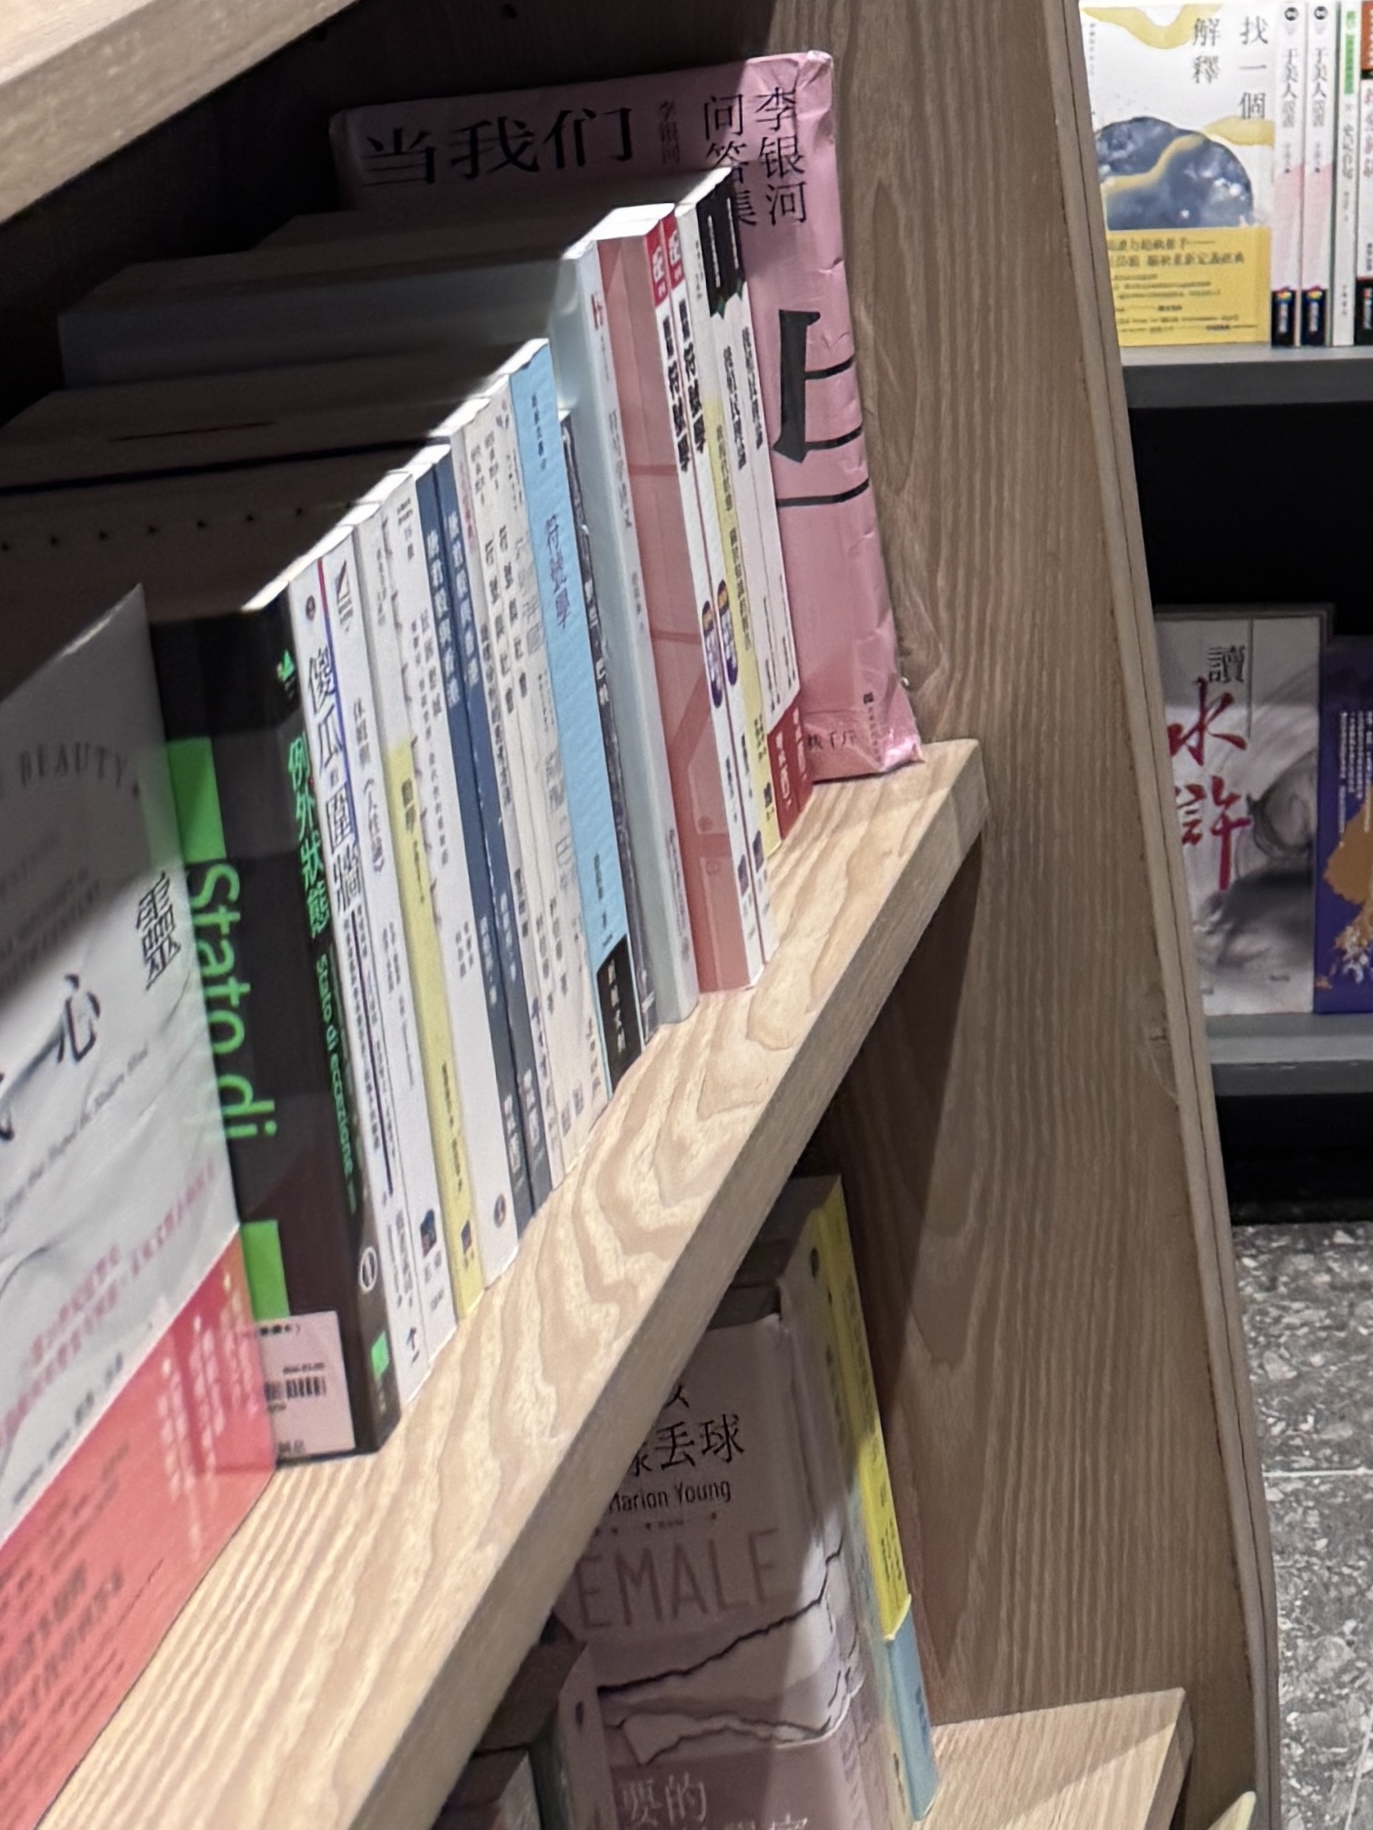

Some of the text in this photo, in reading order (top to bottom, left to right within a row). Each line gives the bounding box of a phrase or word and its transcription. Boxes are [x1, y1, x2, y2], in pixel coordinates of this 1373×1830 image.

[1191, 17, 1269, 120] 找一個 解釋
[358, 106, 638, 189] 当我们
[19, 741, 128, 787] BEAUTY
[286, 734, 331, 938] 例外狀態
[1167, 645, 1252, 893] 讀 水滸
[189, 862, 277, 1140] Stato di
